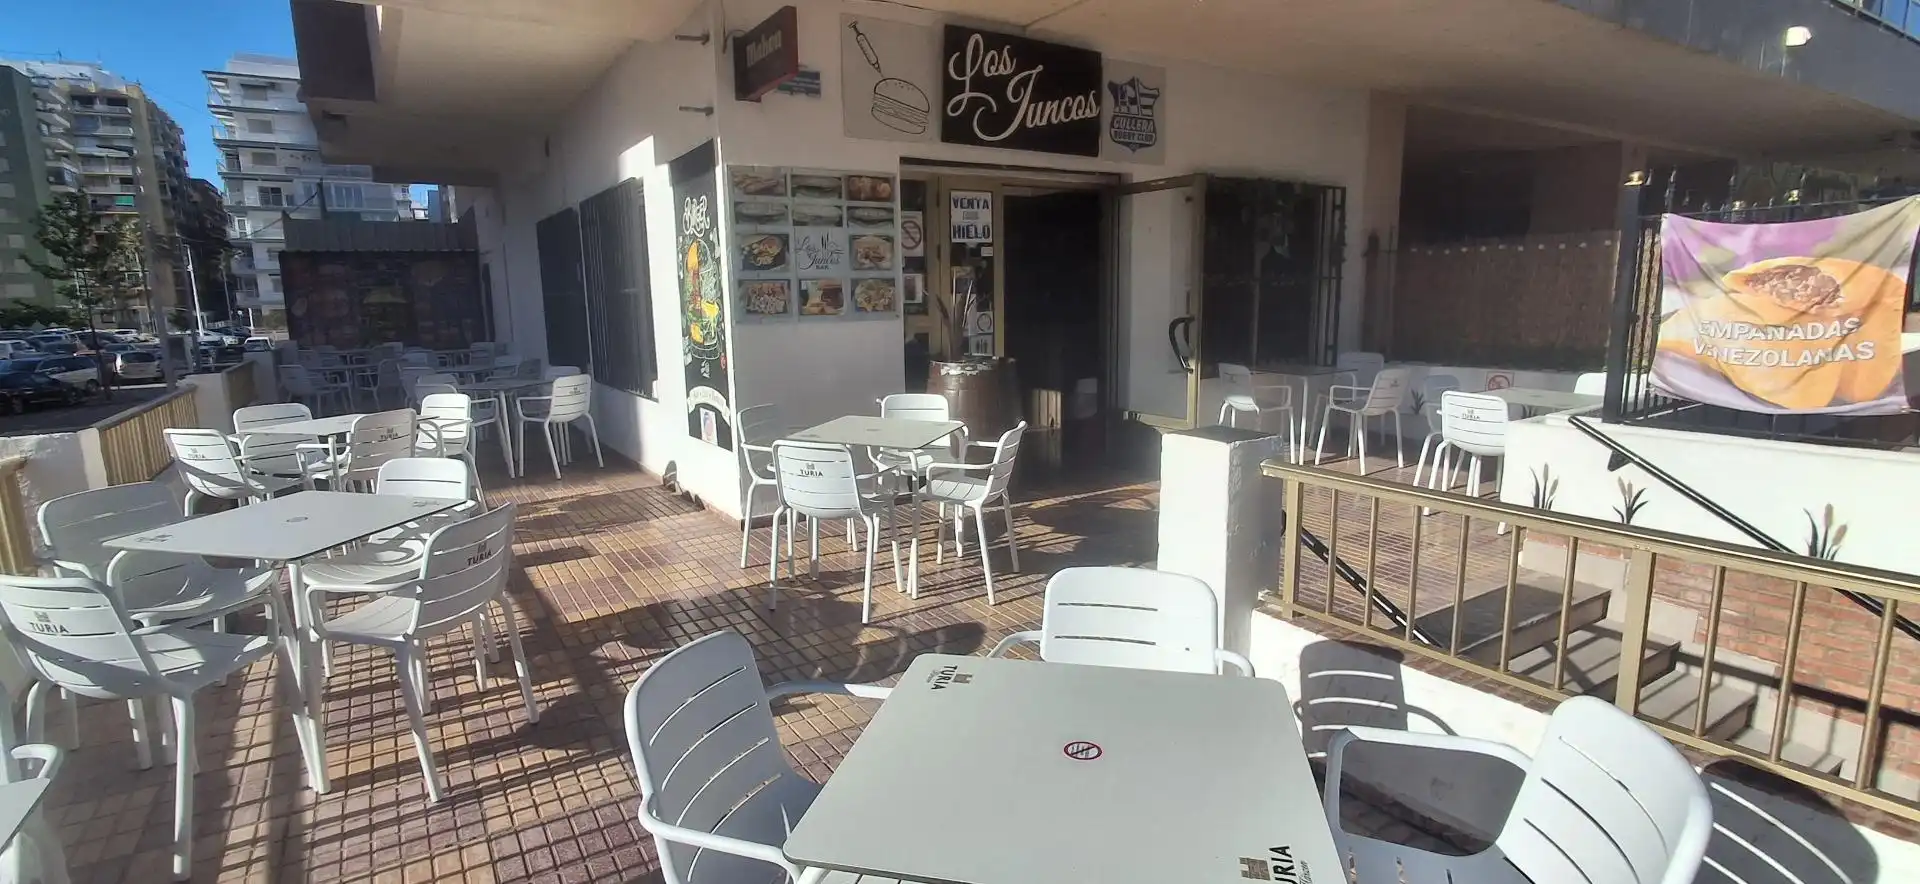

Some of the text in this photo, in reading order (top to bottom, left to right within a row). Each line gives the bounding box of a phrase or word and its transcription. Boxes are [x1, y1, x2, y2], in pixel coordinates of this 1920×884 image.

[946, 33, 1017, 116] Los
[972, 64, 1100, 141] Juncos
[952, 196, 990, 210] VENTA
[952, 224, 991, 240] HIELO
[1699, 318, 1861, 341] EMPANADAS
[1693, 337, 1875, 367] VENEZOLANAS
[799, 469, 824, 477] TURIA
[467, 549, 492, 566] TURIA
[29, 621, 70, 633] TURIA
[931, 665, 958, 690] TURIA
